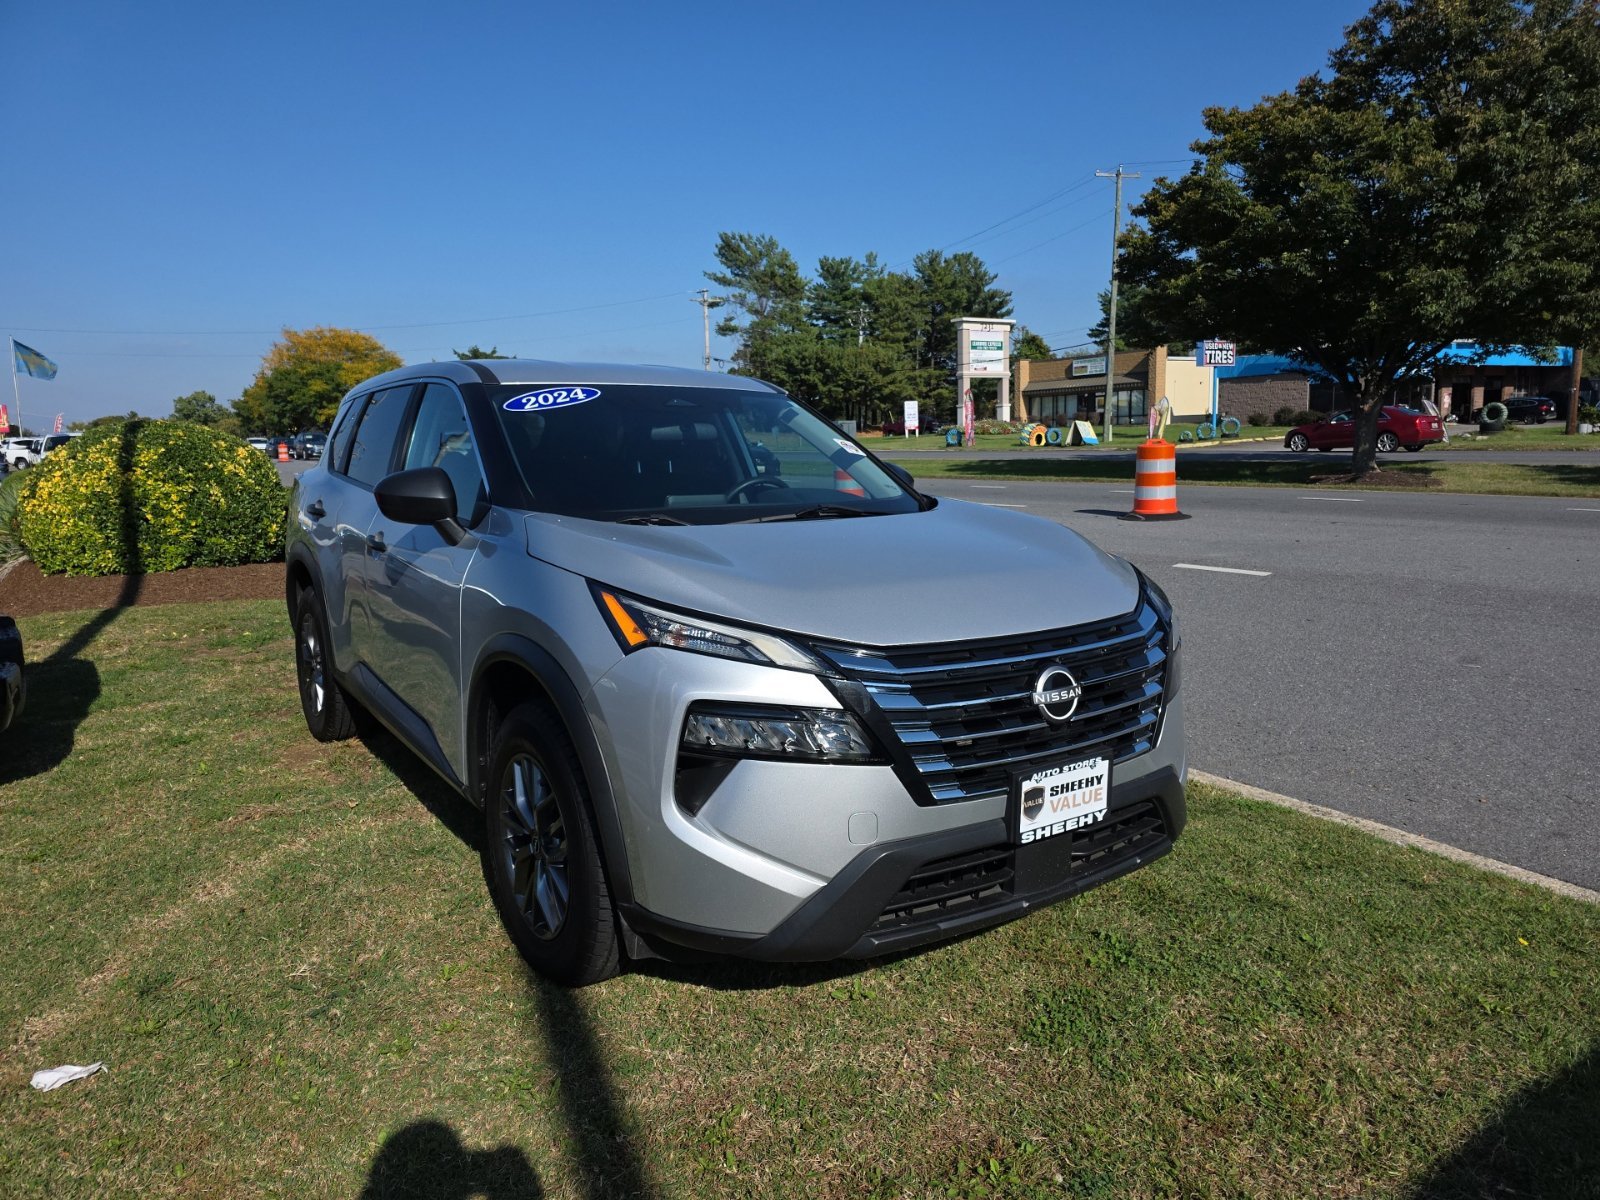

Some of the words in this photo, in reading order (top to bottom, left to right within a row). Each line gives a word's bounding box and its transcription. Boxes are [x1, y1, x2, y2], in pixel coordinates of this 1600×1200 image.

[1205, 342, 1218, 350] USED
[1222, 342, 1234, 350] NEW
[1205, 350, 1234, 364] TIRES
[521, 388, 587, 410] 2024
[1034, 686, 1082, 703] NISSAN
[1030, 768, 1060, 782] AUTO
[1062, 756, 1102, 773] STORES
[1049, 774, 1104, 797] SHEEHY
[1023, 797, 1044, 808] VALUE
[1049, 787, 1103, 814] VALUE
[1021, 808, 1108, 844] SHEEHY
